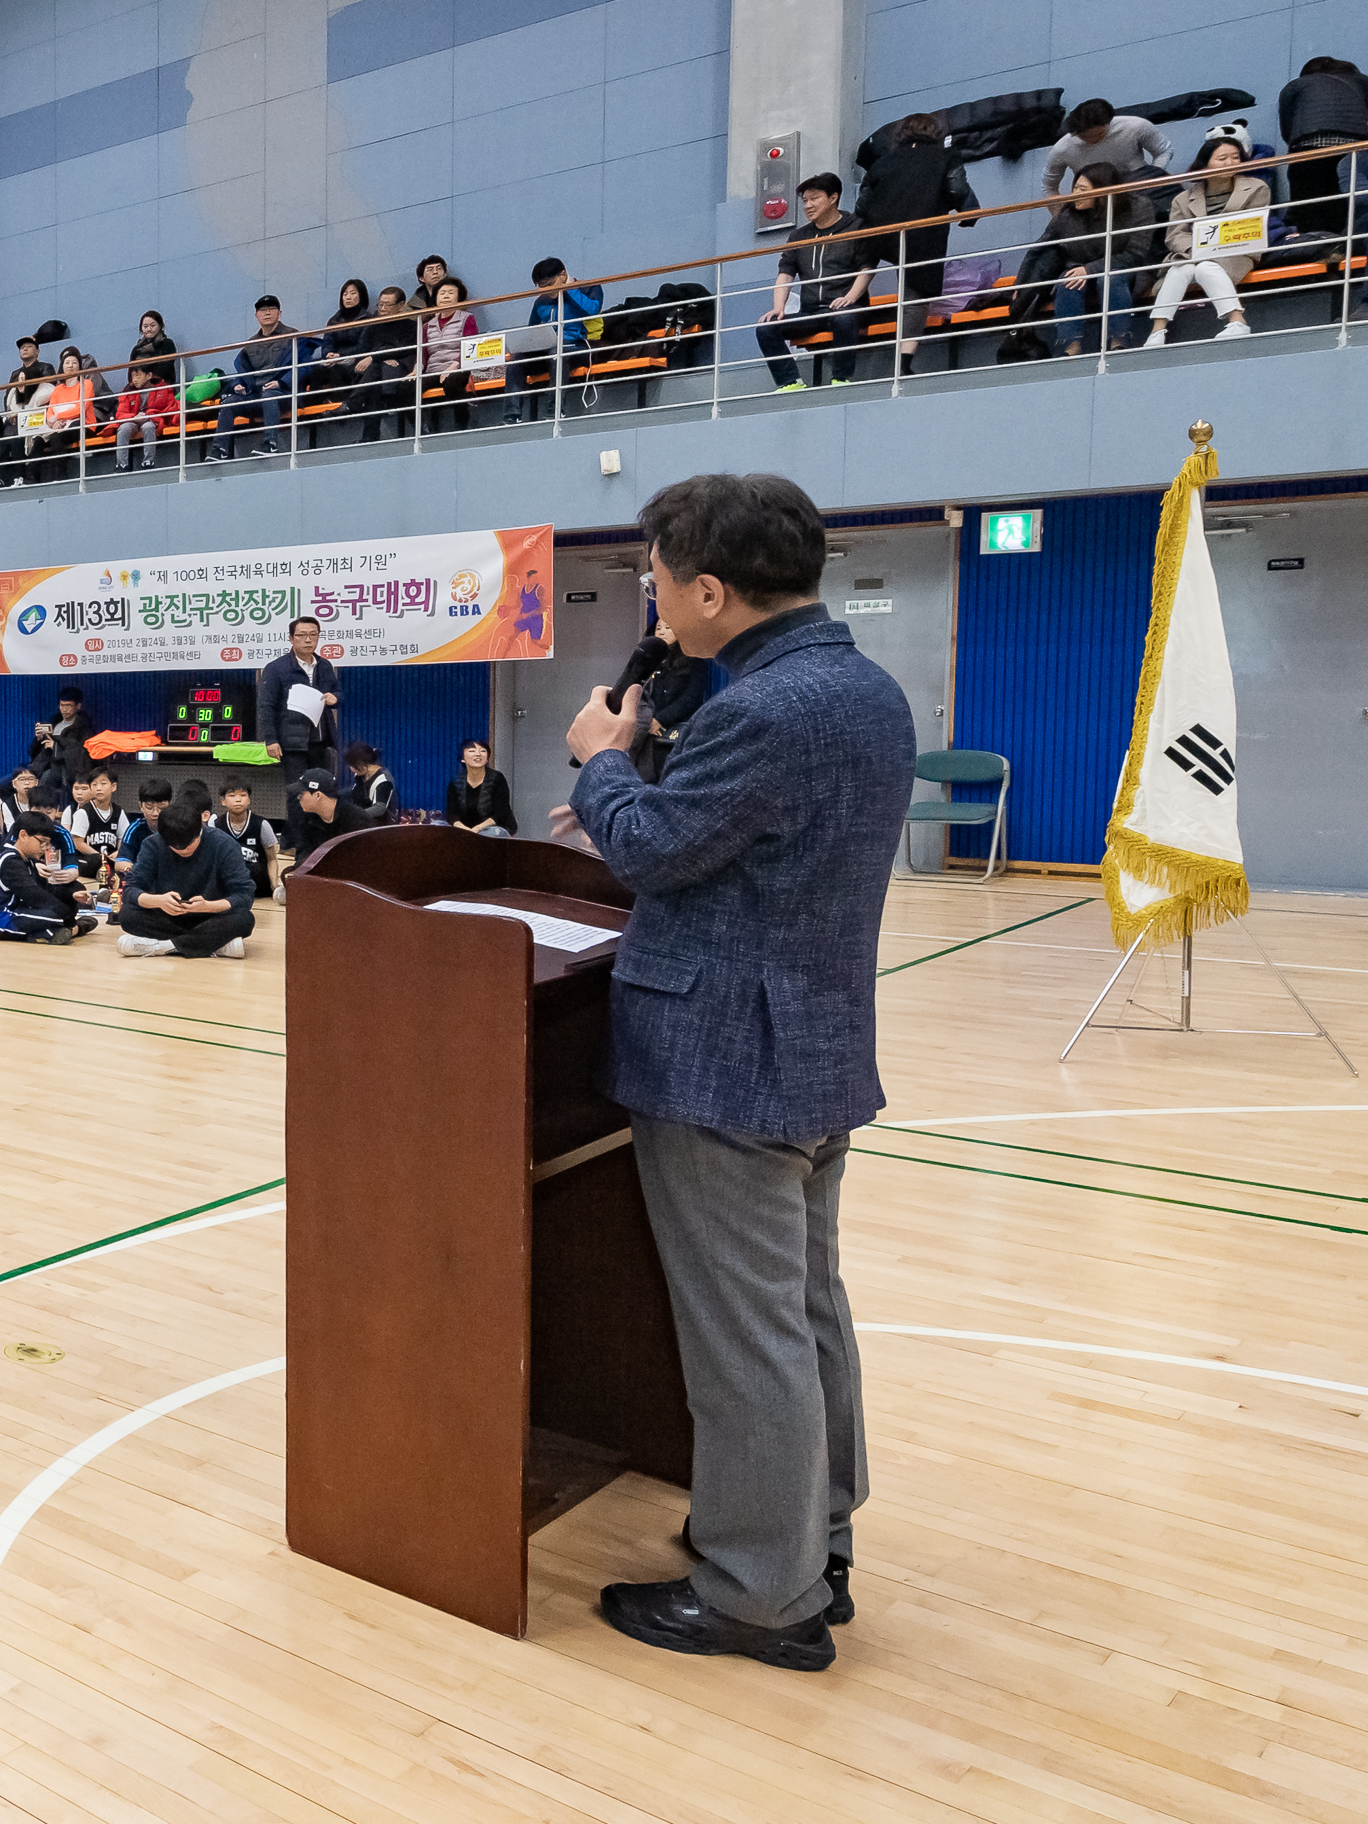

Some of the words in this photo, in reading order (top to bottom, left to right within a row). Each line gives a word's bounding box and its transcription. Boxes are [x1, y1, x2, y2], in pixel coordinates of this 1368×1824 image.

[173, 566, 208, 582] 100회
[213, 560, 292, 581] 전국체육대회
[297, 556, 353, 577] 성공개최
[53, 597, 130, 632] 제13회
[138, 586, 299, 629] 광진구청장기
[310, 578, 437, 622] 농구대회
[448, 603, 482, 617] GBA
[87, 640, 102, 650] 일시
[107, 638, 133, 649] 2019년
[171, 635, 196, 646] 3월3일
[231, 632, 264, 644] 2월24일
[318, 627, 385, 640] 곡문화체육센타)
[222, 649, 240, 660] 주최
[322, 646, 342, 657] 주관
[349, 643, 419, 657] 광진구농구협회
[61, 655, 76, 666] 장소
[178, 707, 186, 718] 0
[198, 709, 212, 721] 30
[224, 707, 232, 718] 0
[189, 727, 197, 740] 0
[201, 729, 208, 741] 0
[231, 727, 240, 740] 0
